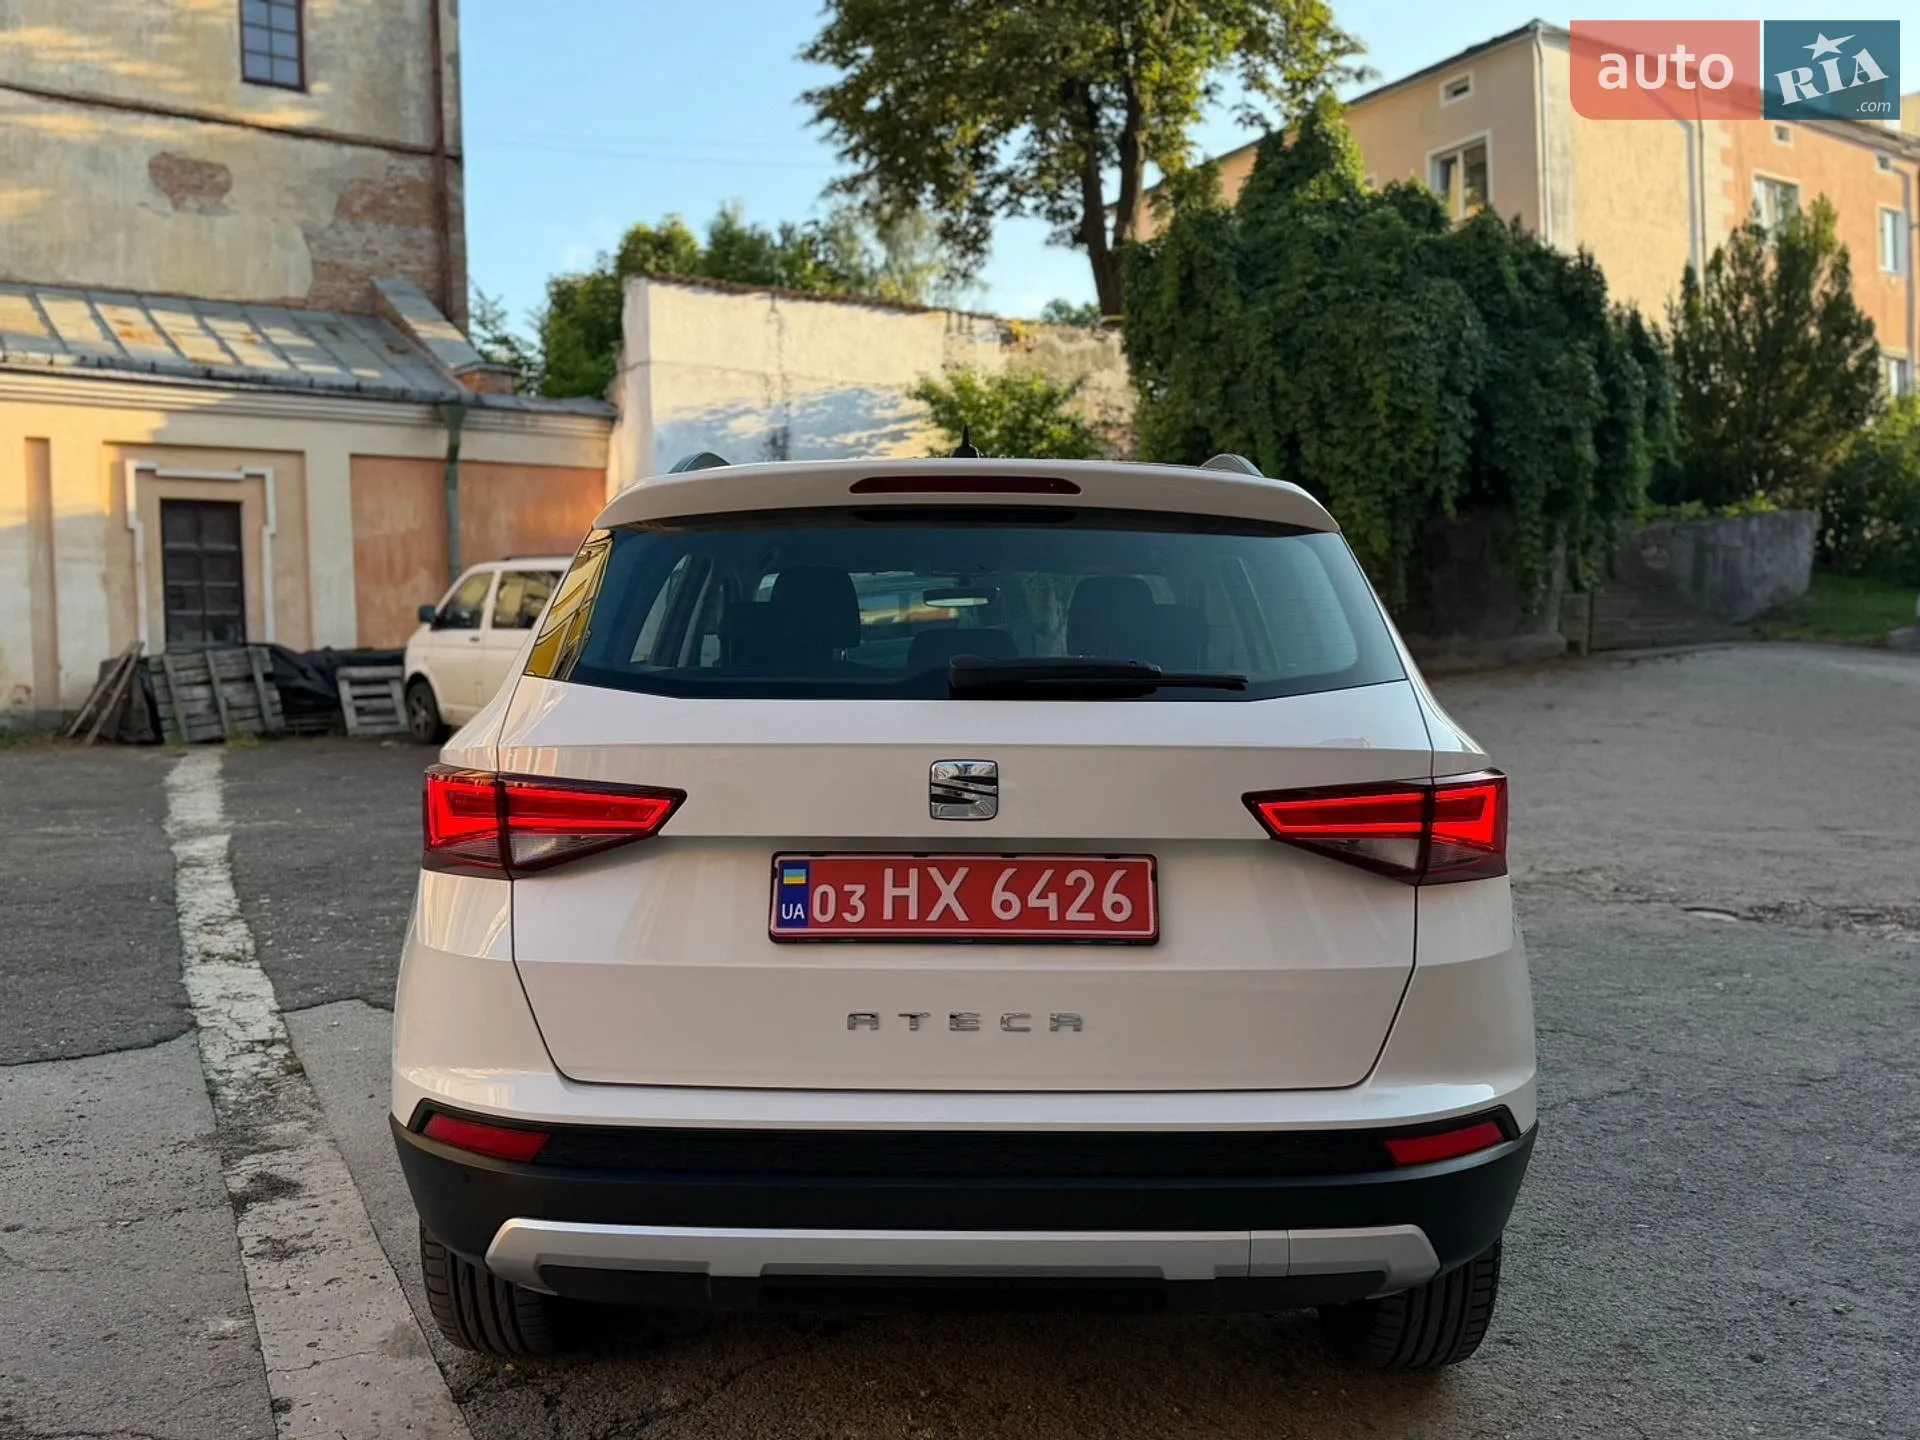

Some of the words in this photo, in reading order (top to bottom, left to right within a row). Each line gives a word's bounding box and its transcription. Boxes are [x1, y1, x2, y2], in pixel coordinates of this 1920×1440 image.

[811, 884, 866, 923] 03
[882, 867, 970, 922] HX
[990, 868, 1133, 923] 6426
[781, 903, 806, 920] UA
[846, 1012, 1083, 1032] ATECA
